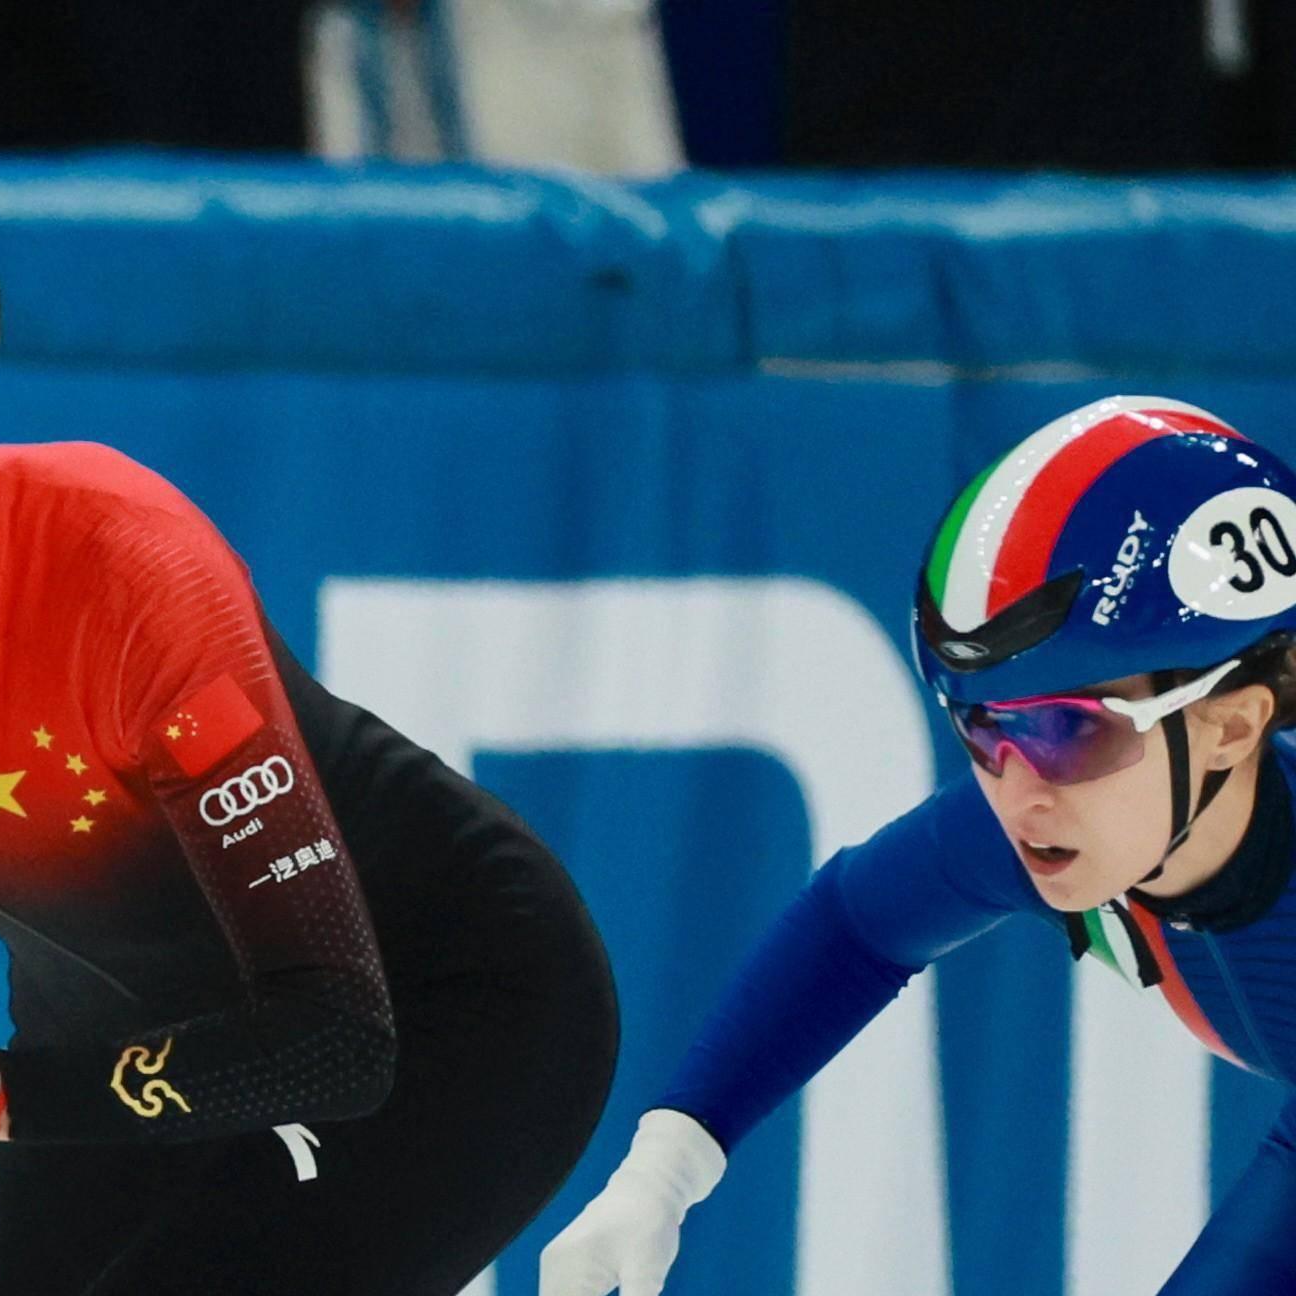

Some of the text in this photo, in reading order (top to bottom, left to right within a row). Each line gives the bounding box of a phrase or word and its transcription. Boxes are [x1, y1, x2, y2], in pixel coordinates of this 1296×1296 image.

[1092, 510, 1148, 626] RUDY
[1210, 507, 1296, 594] 30
[222, 817, 264, 849] Audi
[248, 837, 337, 889] 一汽奥迪
